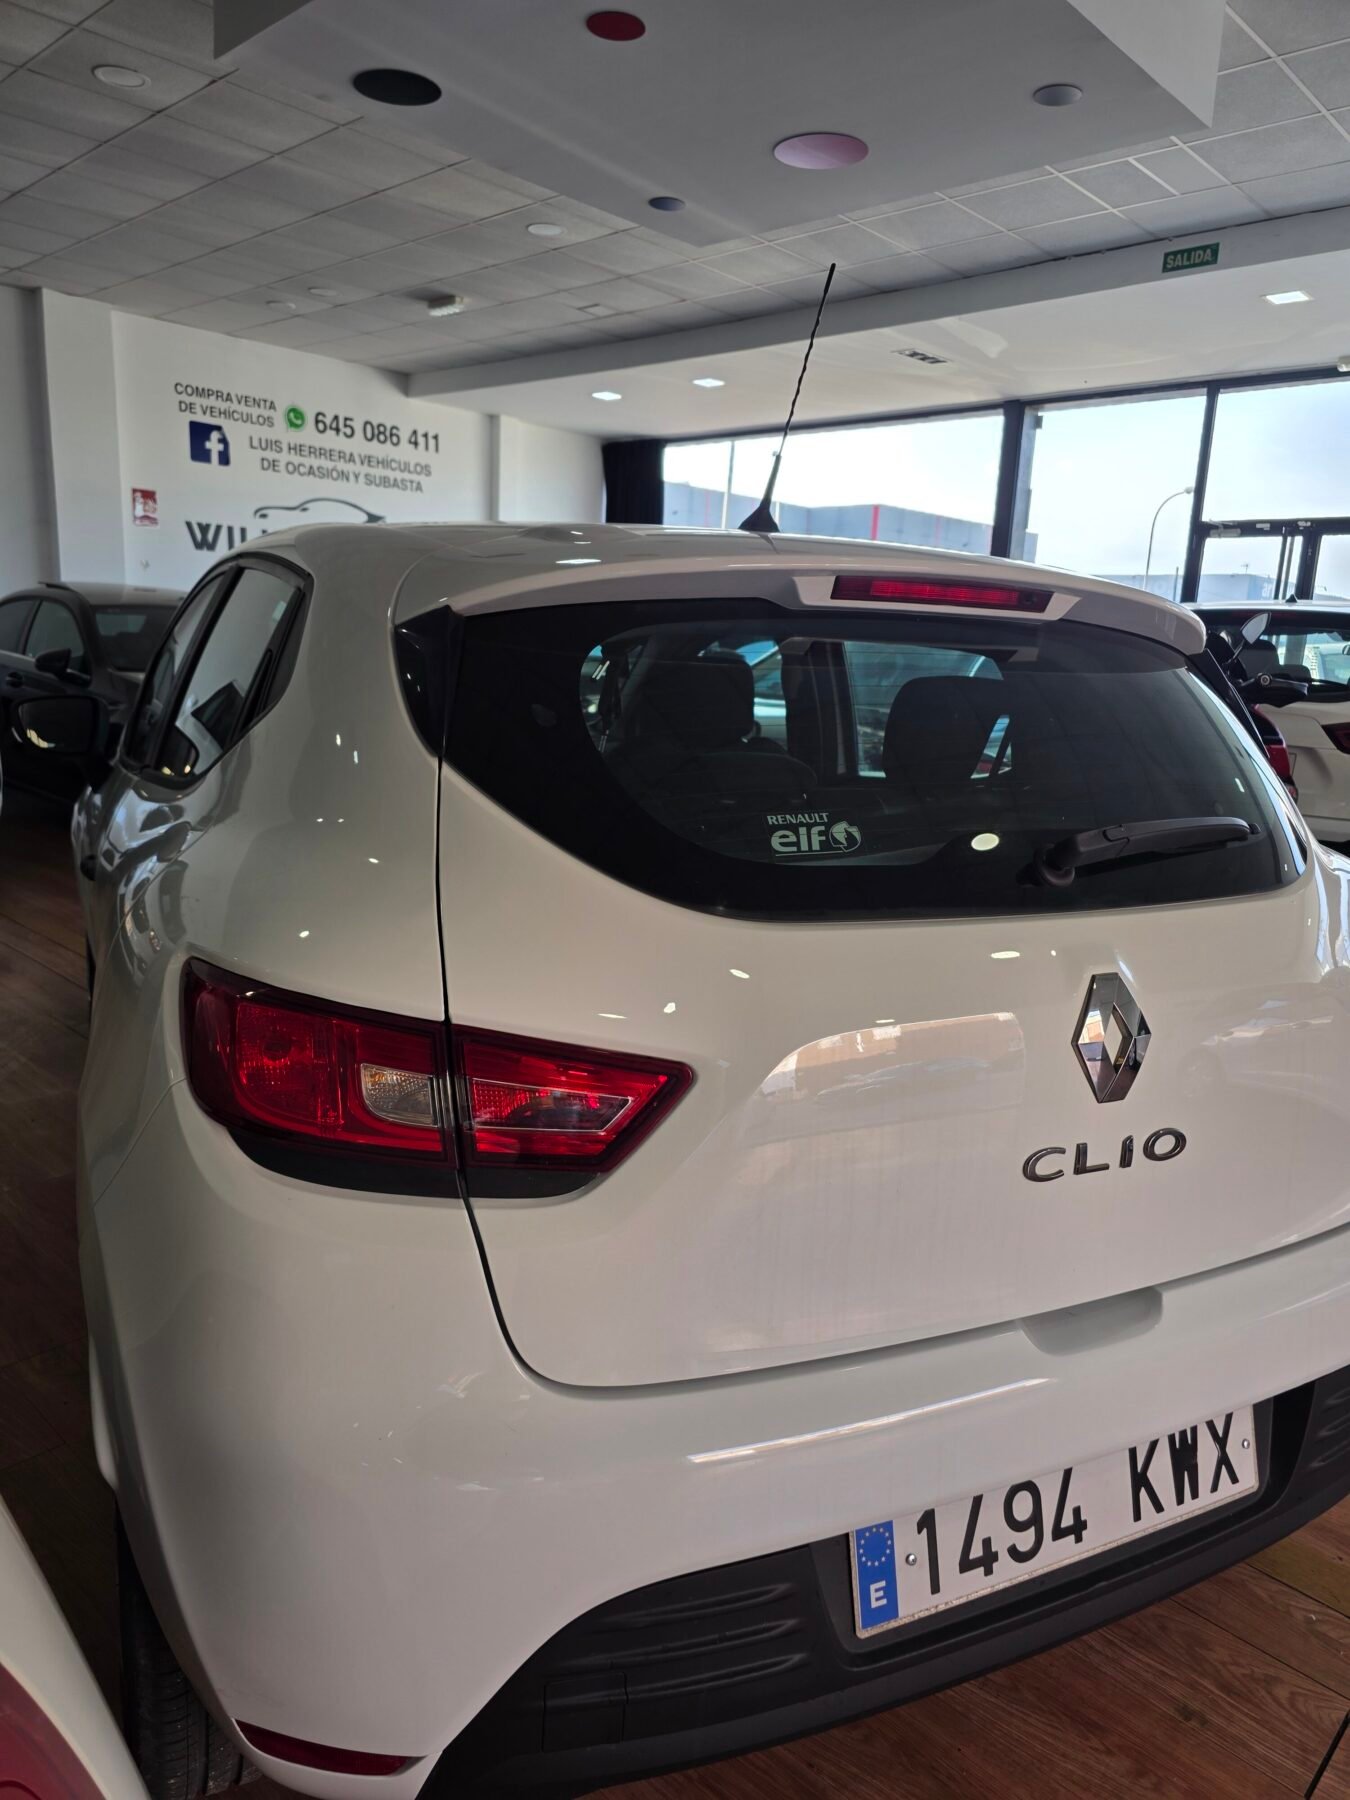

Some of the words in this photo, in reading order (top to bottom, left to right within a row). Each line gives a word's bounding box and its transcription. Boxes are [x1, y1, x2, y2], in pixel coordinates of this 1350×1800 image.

[1166, 248, 1212, 268] SALIDA
[174, 382, 233, 404] COMPRA
[235, 393, 277, 412] VENTA
[178, 400, 197, 414] DE
[200, 404, 275, 428] VEHÍCULOS
[314, 411, 355, 439] 645
[363, 420, 401, 447] 086
[408, 429, 439, 454] 411
[249, 435, 283, 454] LUIS
[288, 442, 356, 466] HERRERA
[358, 453, 432, 477] VEHÍCULOS
[261, 456, 281, 473] DE
[285, 461, 350, 483] OCASIÓN
[353, 471, 361, 484] Y
[364, 473, 424, 494] SUBASTA
[767, 812, 829, 825] RENAULT
[770, 825, 826, 852] elf
[1022, 1127, 1187, 1182] CLIO
[916, 1467, 1088, 1595] 1494
[1128, 1412, 1240, 1523] KWX
[916, 1467, 1088, 1595] 1494
